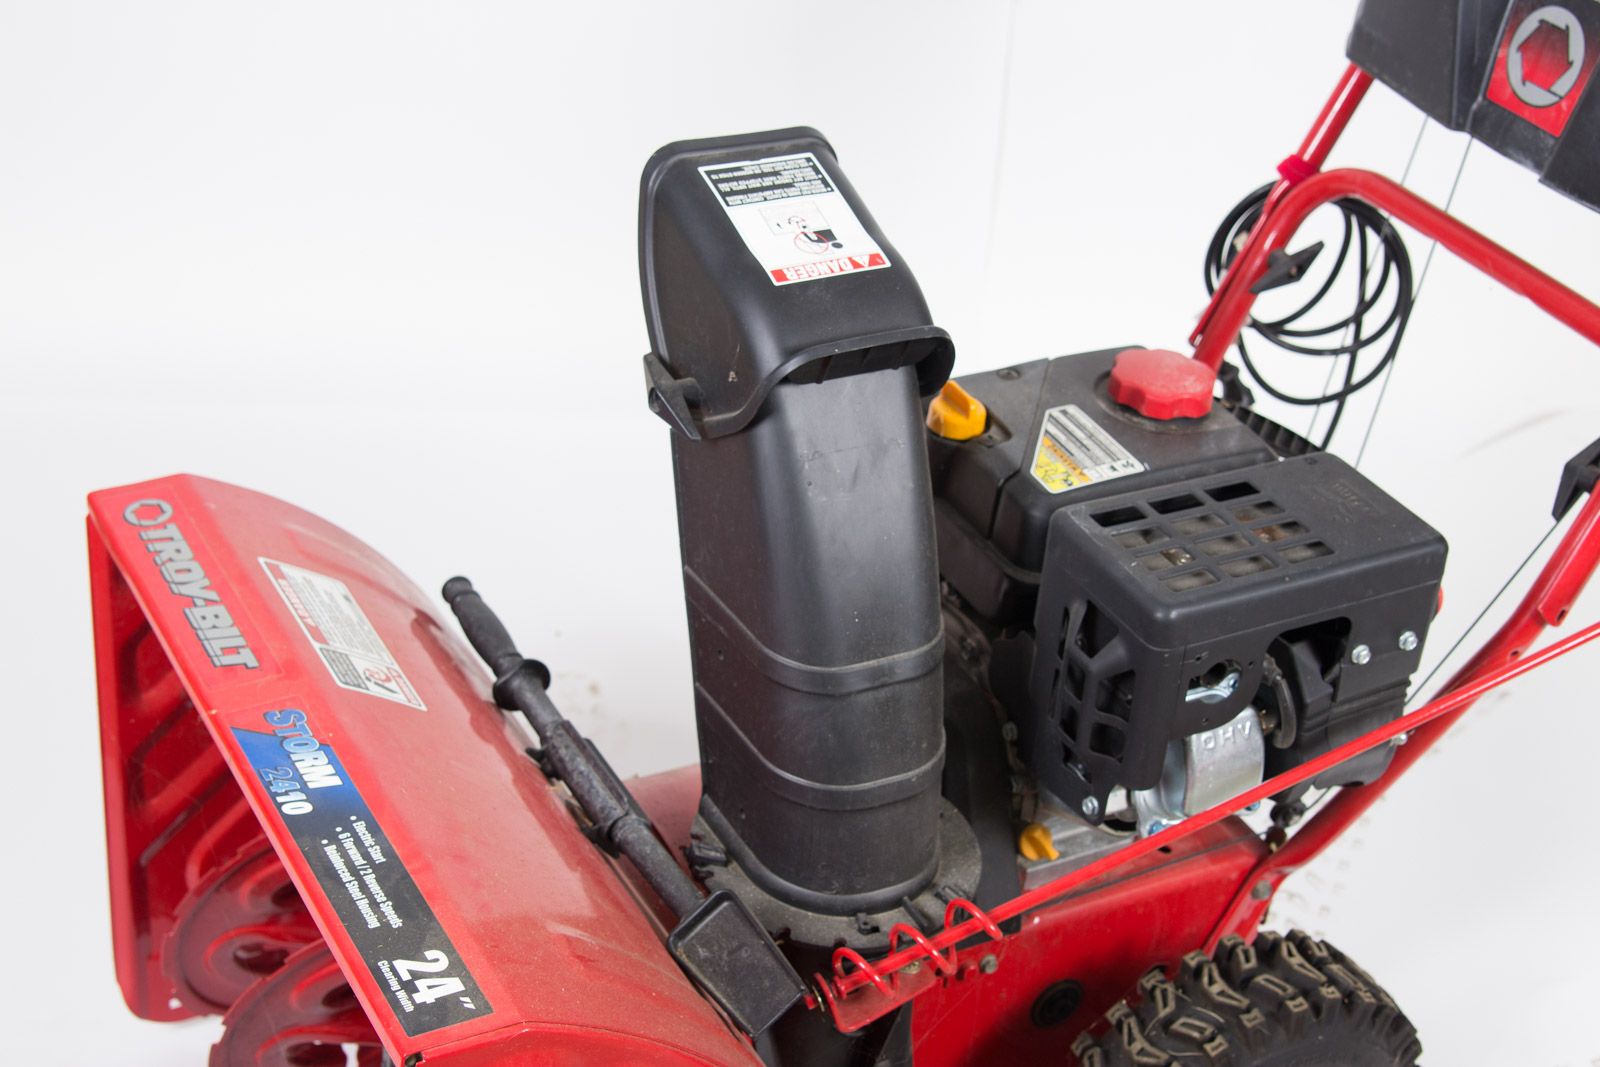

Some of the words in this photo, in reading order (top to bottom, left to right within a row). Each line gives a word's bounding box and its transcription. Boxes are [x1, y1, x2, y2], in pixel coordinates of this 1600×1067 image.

[781, 257, 854, 281] DANGER
[138, 522, 261, 670] TROY-BILT
[1199, 719, 1250, 744] OHV
[263, 708, 344, 789] STORM
[257, 766, 314, 816] 2410
[338, 832, 351, 840] 6
[352, 820, 375, 847] Electric
[367, 845, 387, 864] Start
[323, 844, 356, 883] Reinforced
[341, 837, 367, 866] Forward
[359, 868, 373, 876] 2
[345, 880, 367, 901] Steel
[363, 873, 387, 903] Reverse
[355, 898, 381, 929] Housing
[379, 900, 403, 929] Speeds
[377, 959, 402, 992] Clearing
[395, 989, 415, 1013] Width
